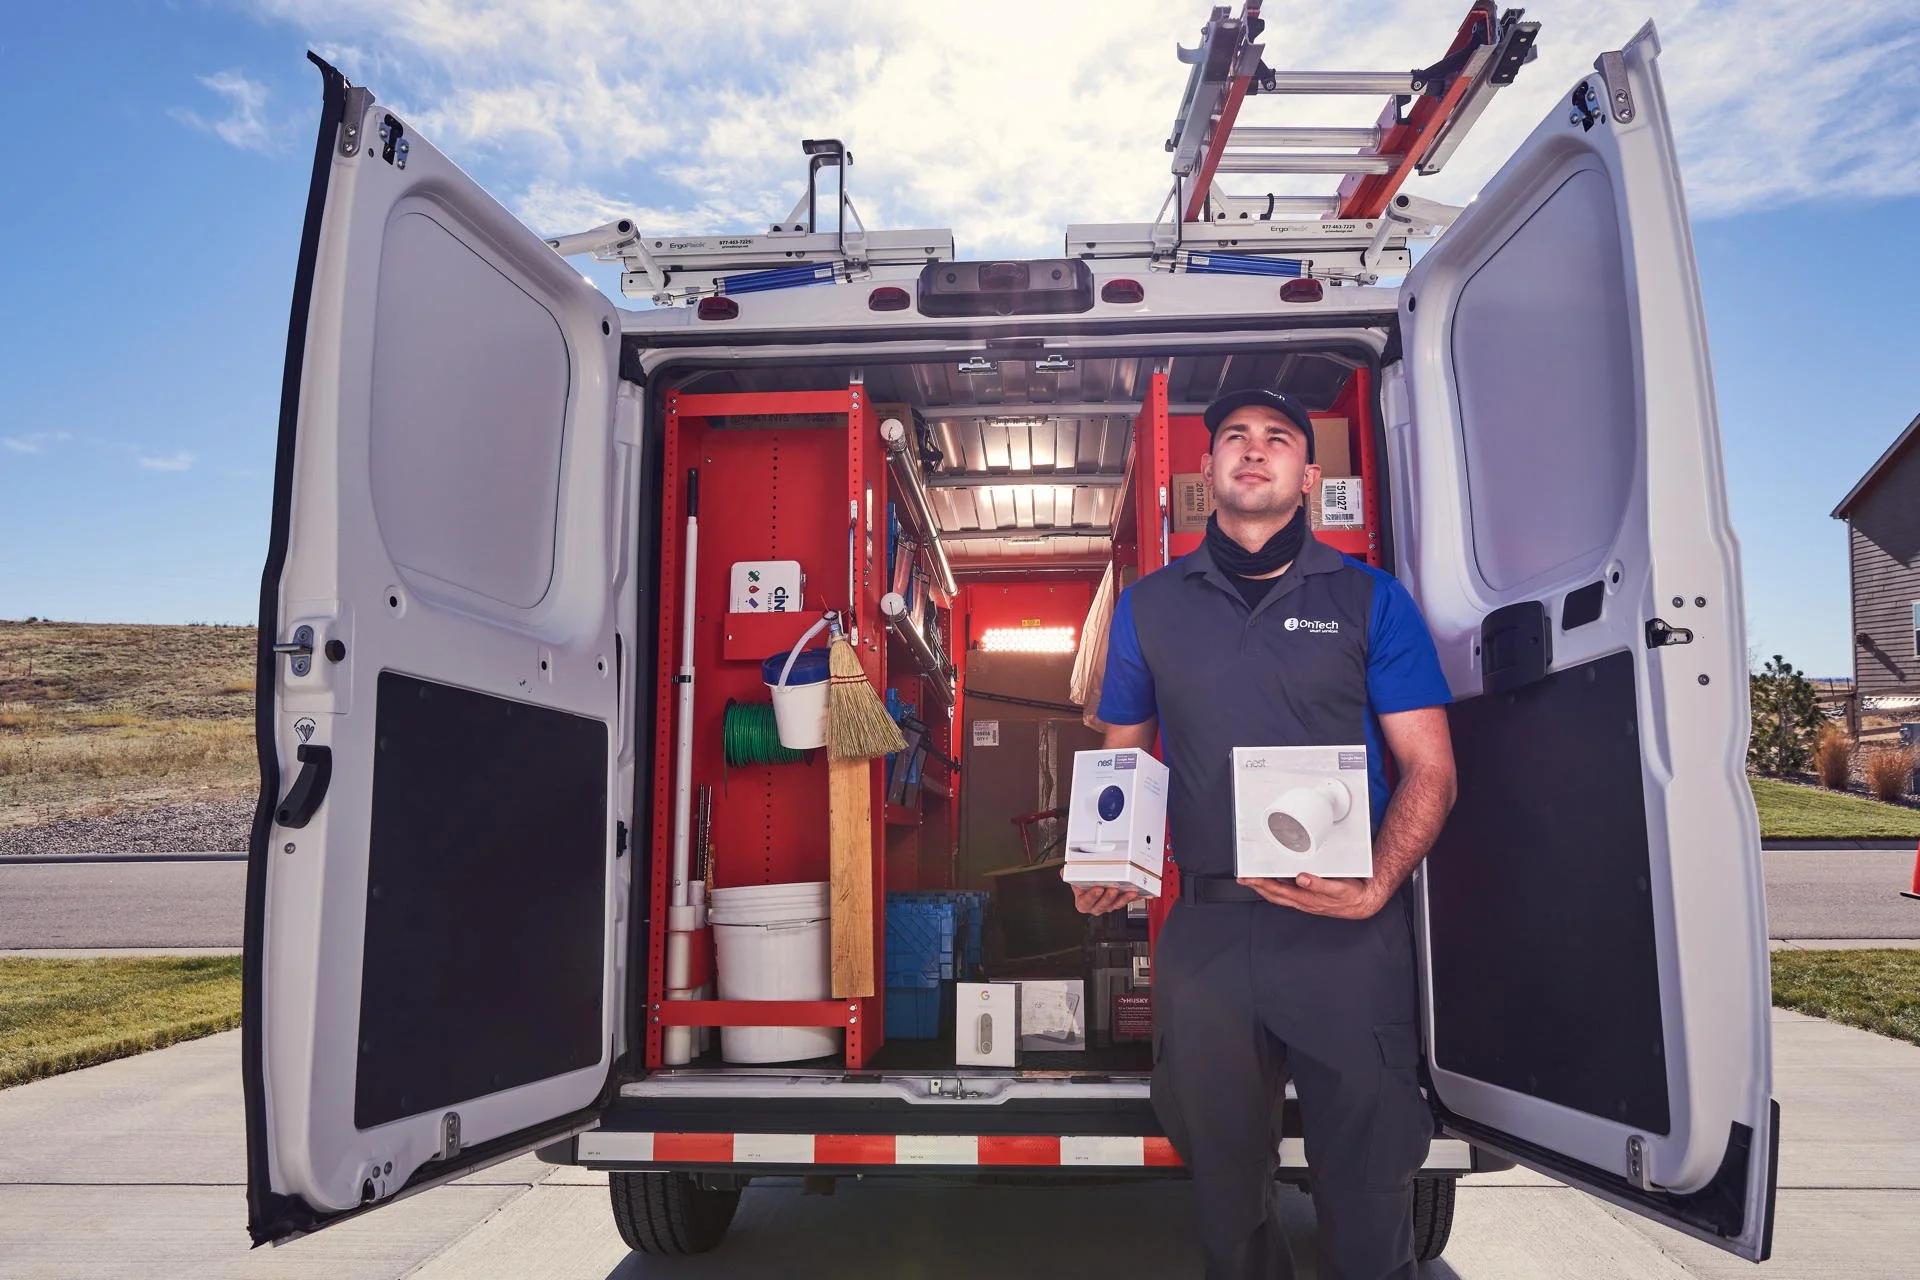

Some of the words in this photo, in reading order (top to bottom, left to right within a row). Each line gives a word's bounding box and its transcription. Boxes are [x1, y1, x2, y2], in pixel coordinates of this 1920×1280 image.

[1196, 482, 1205, 512] 201700
[1336, 480, 1347, 511] 151027
[1299, 619, 1339, 630] OnTech
[1097, 759, 1113, 768] nest
